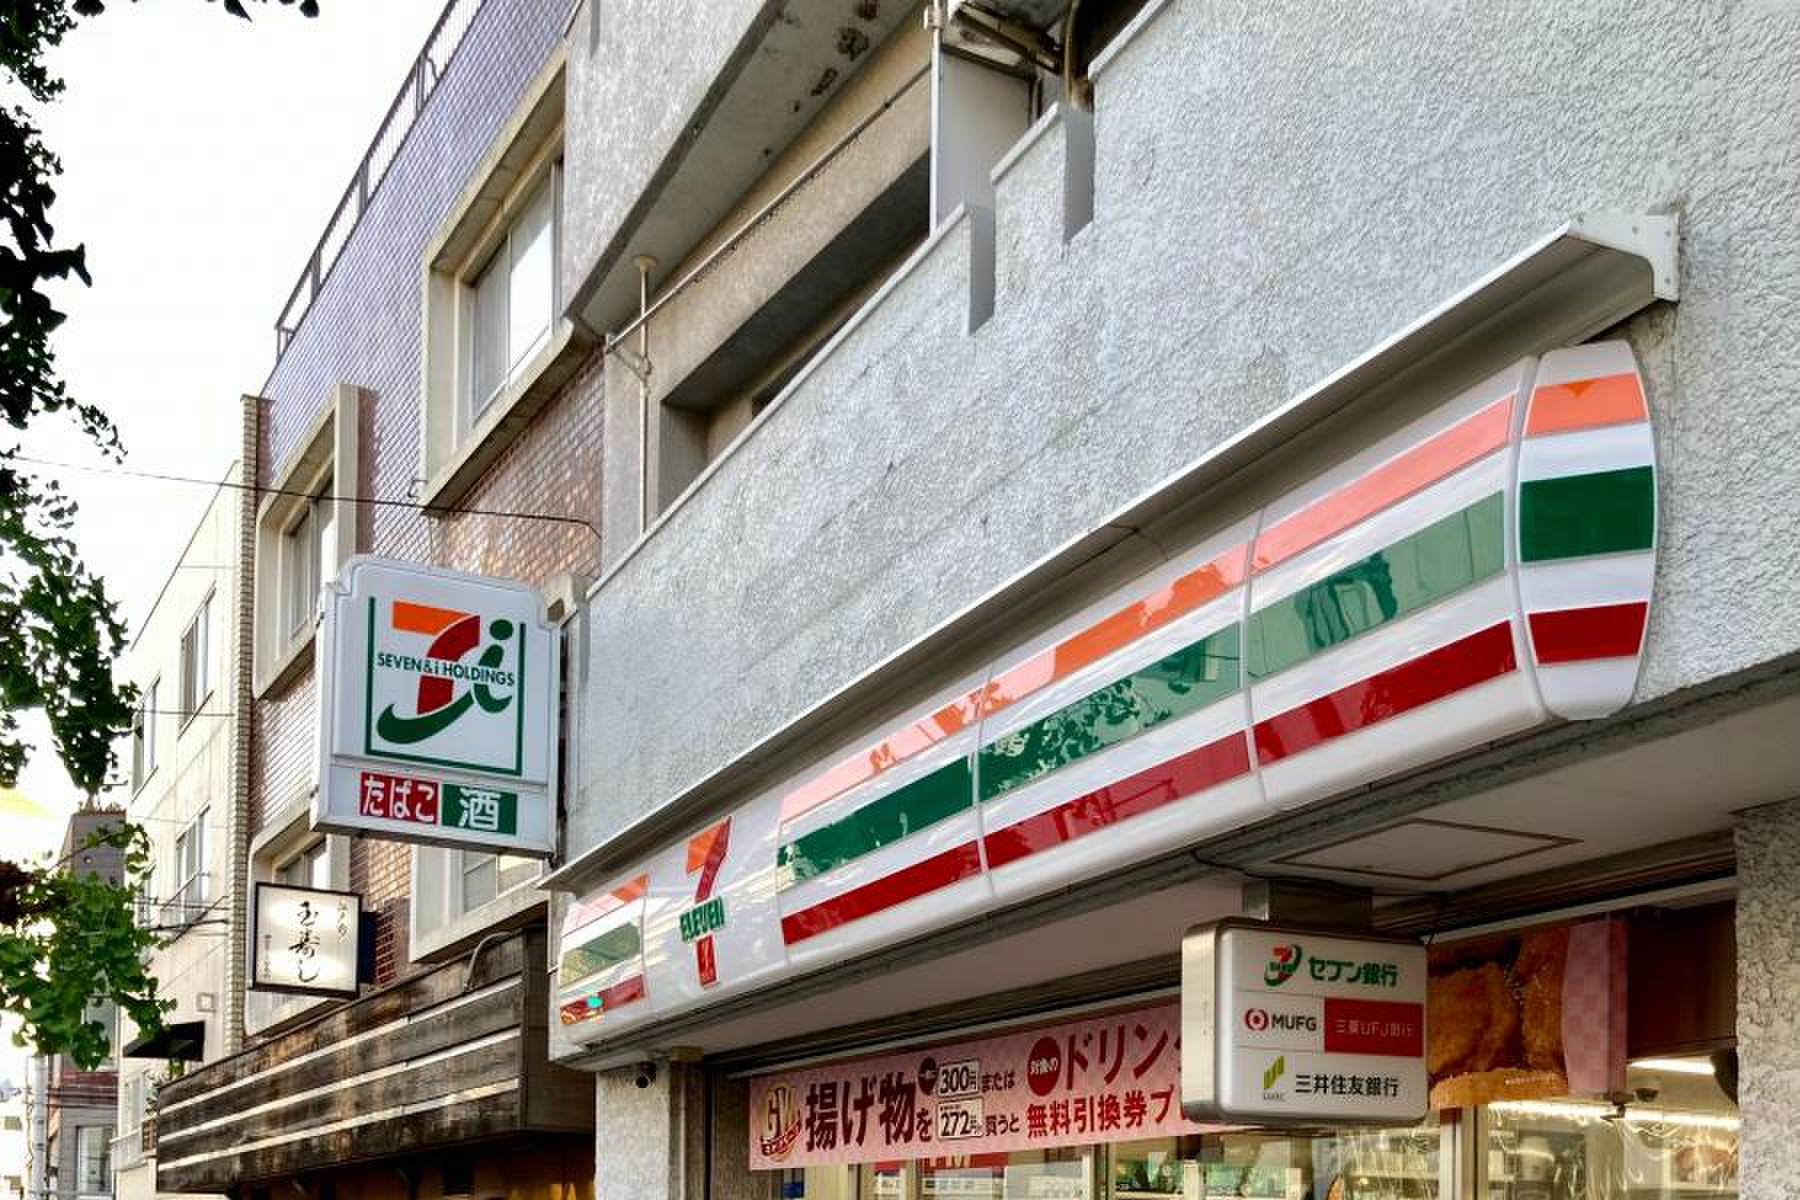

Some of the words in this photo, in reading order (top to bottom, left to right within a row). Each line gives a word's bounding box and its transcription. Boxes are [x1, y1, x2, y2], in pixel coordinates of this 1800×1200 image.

[443, 662, 515, 687] HOLDINGS
[363, 776, 435, 824] たばこ
[458, 789, 500, 831] 酒
[1308, 956, 1399, 987] セブン銀行
[1272, 1009, 1317, 1031] MUFG
[1066, 1022, 1182, 1090] ドリン
[982, 1072, 1015, 1093] または
[1296, 1074, 1400, 1097] 三井住友銀行
[1026, 1083, 1188, 1138] 無料引換券プ
[985, 1113, 1020, 1137] 買うと
